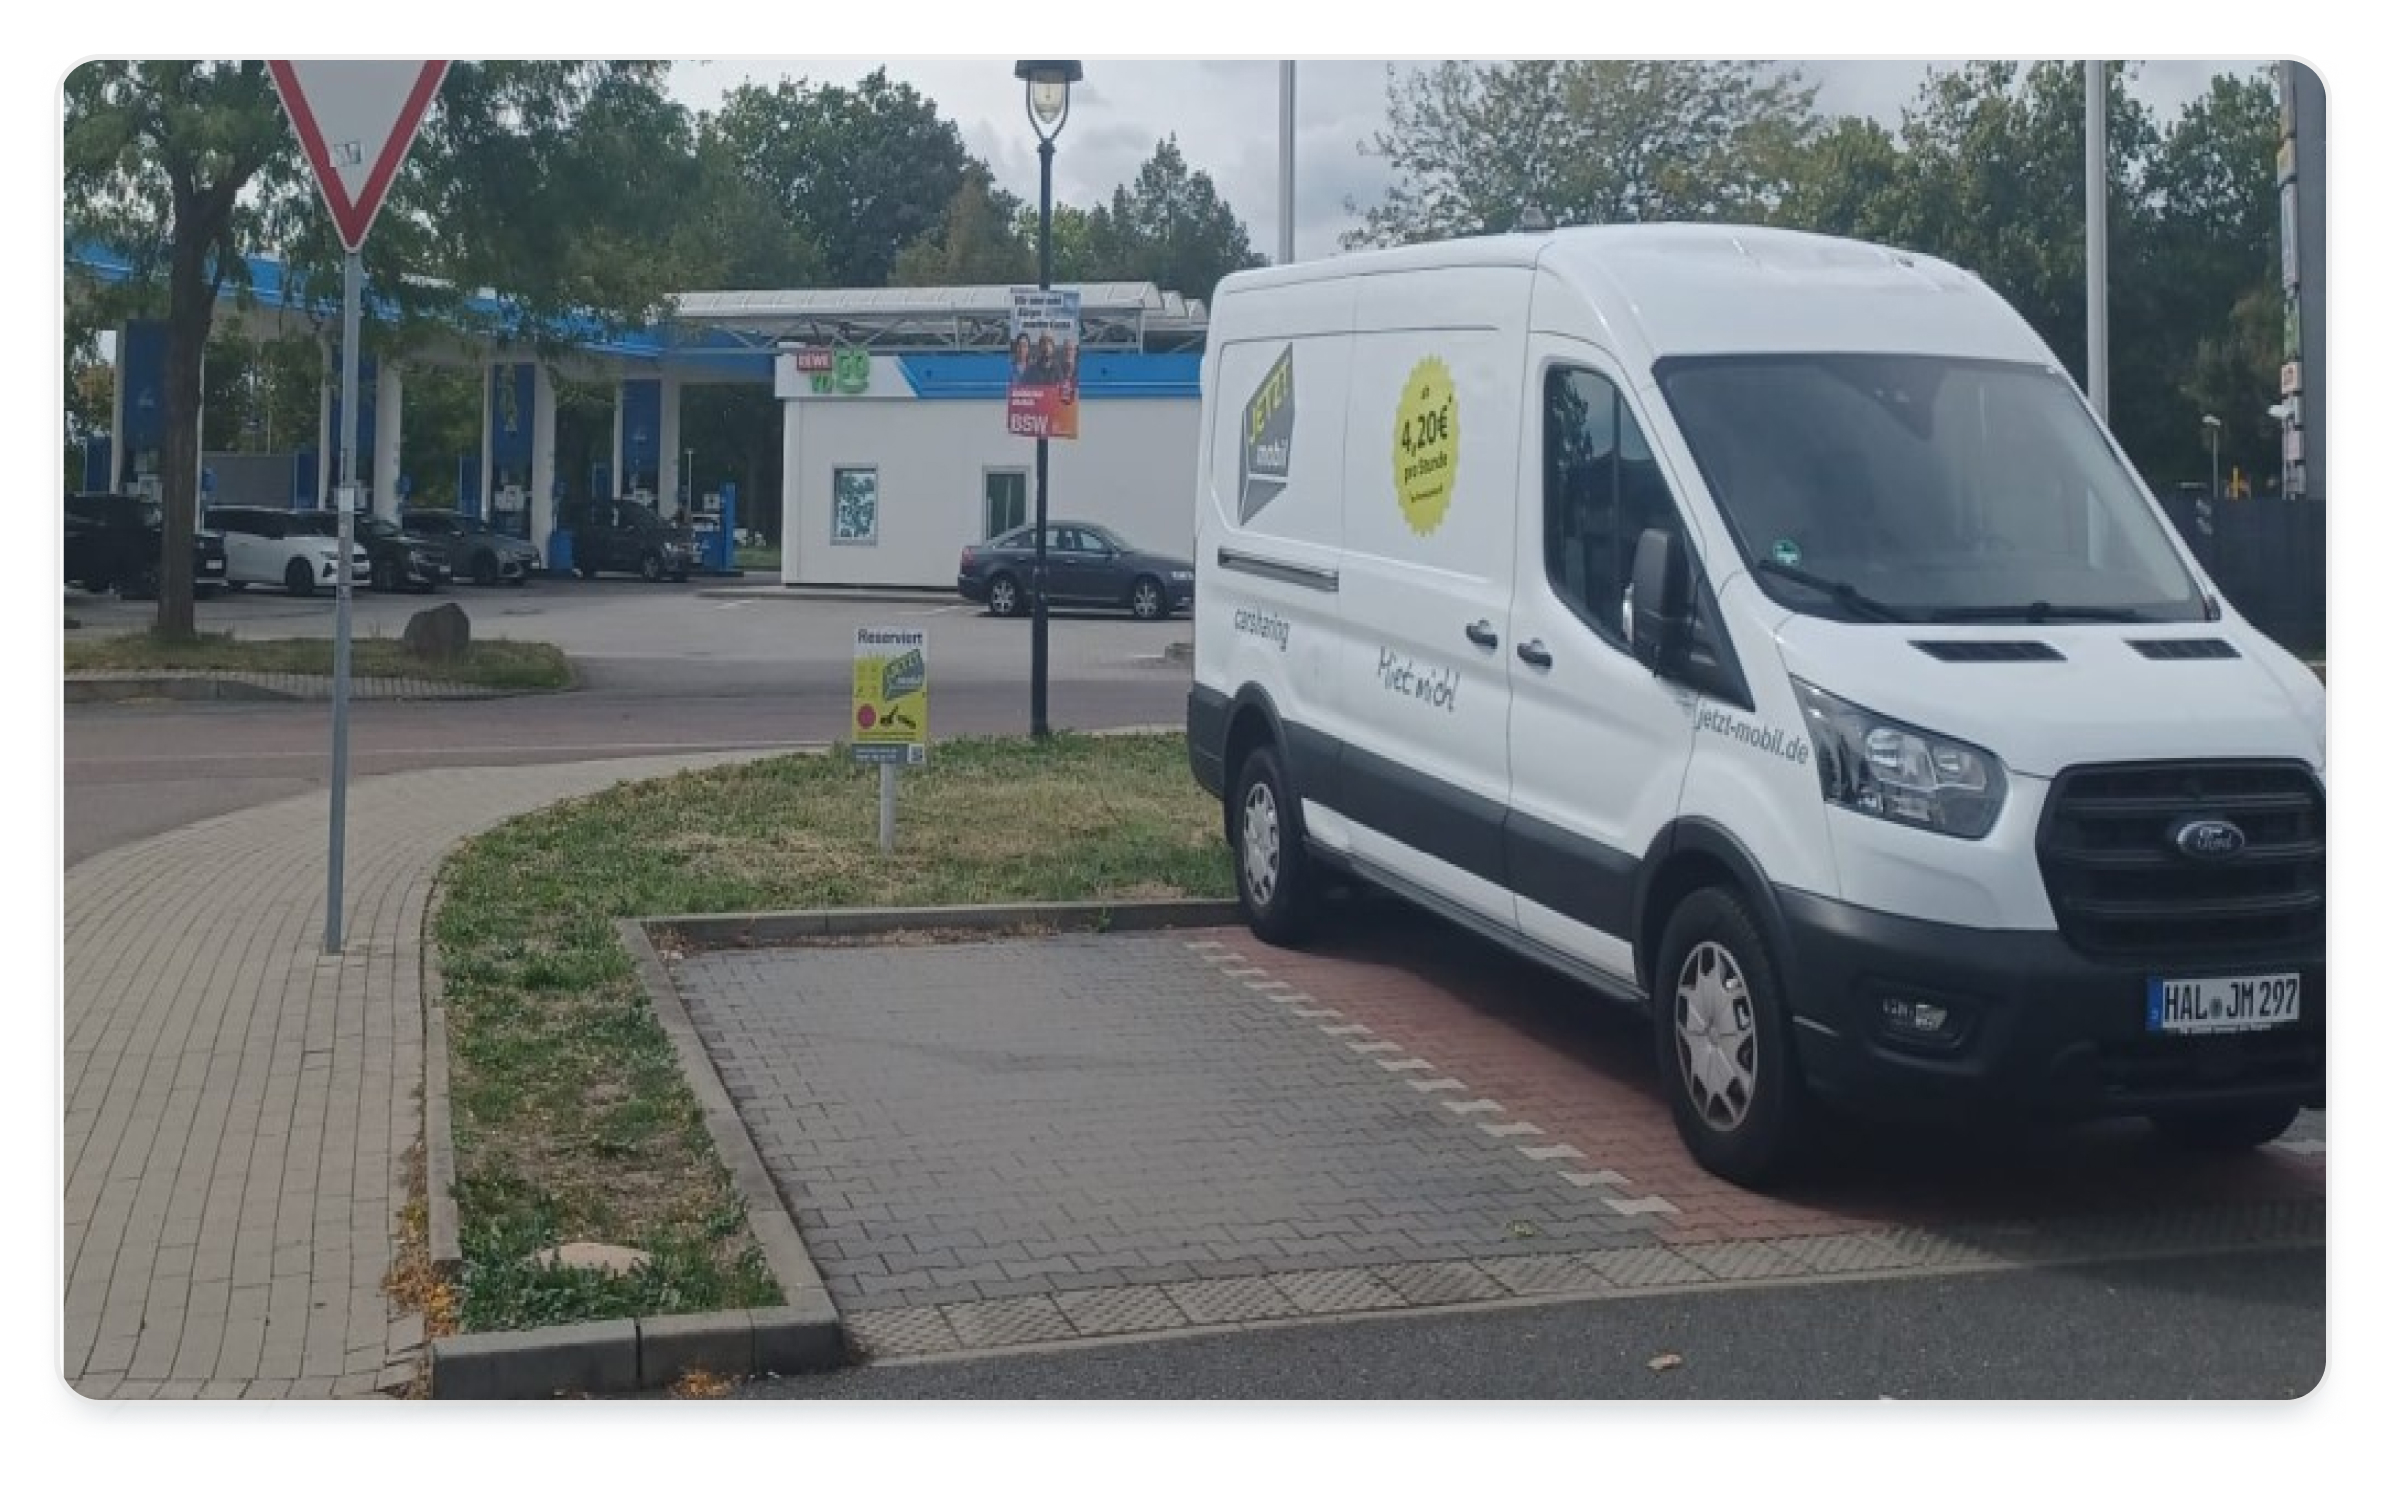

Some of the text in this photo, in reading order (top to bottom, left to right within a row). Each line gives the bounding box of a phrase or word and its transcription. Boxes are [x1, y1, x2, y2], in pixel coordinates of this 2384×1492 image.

[1011, 413, 1049, 434] BSW
[857, 628, 923, 644] Reserviert
[1234, 606, 1289, 652] carsharing
[1694, 702, 1809, 765] jetzt-mobil.de
[2164, 984, 2208, 1020] HAL
[2226, 981, 2254, 1020] JM
[2259, 978, 2298, 1017] 297
